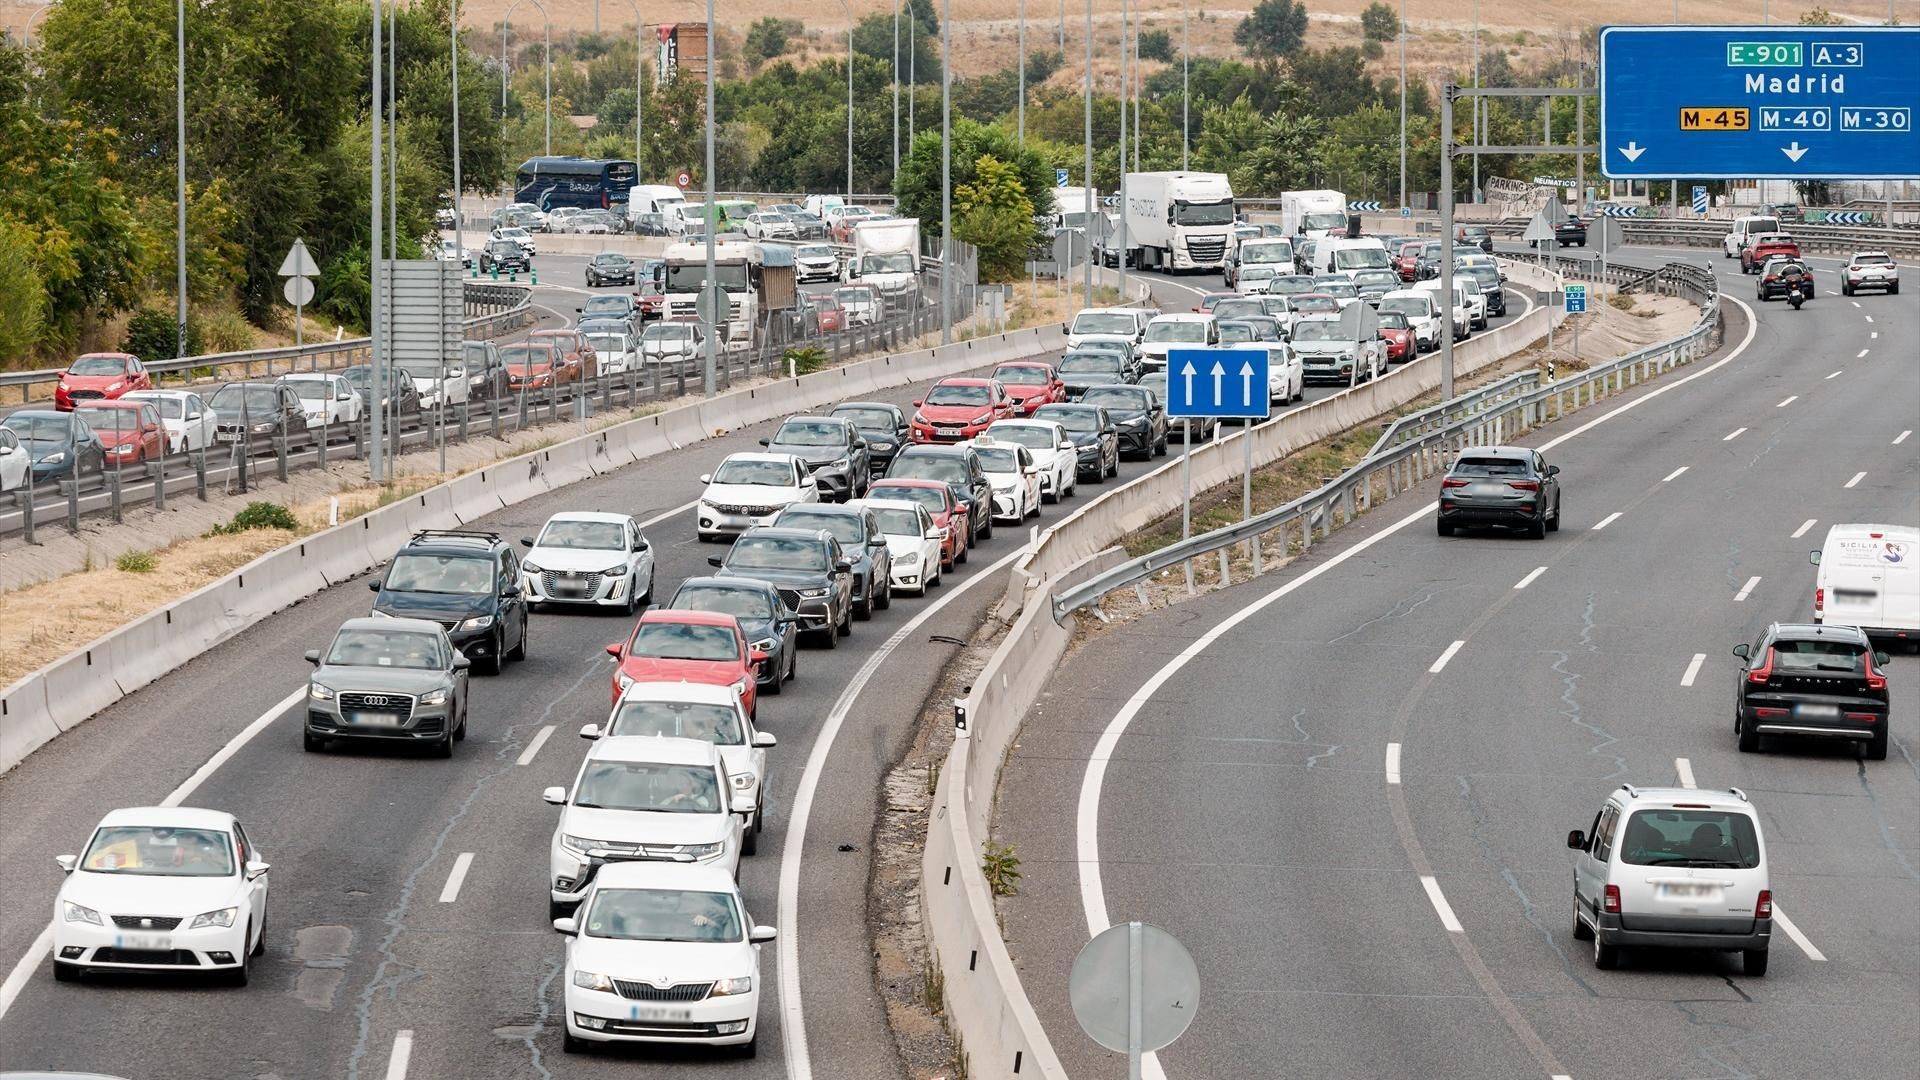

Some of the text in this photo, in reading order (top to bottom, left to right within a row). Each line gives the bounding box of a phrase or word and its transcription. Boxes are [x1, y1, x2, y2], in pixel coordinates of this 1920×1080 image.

[1730, 46, 1859, 64] E-901 A-3
[1744, 73, 1845, 94] Madrid
[1683, 110, 1906, 128] M-45 M-40 M-30
[1491, 176, 1525, 192] PARKING
